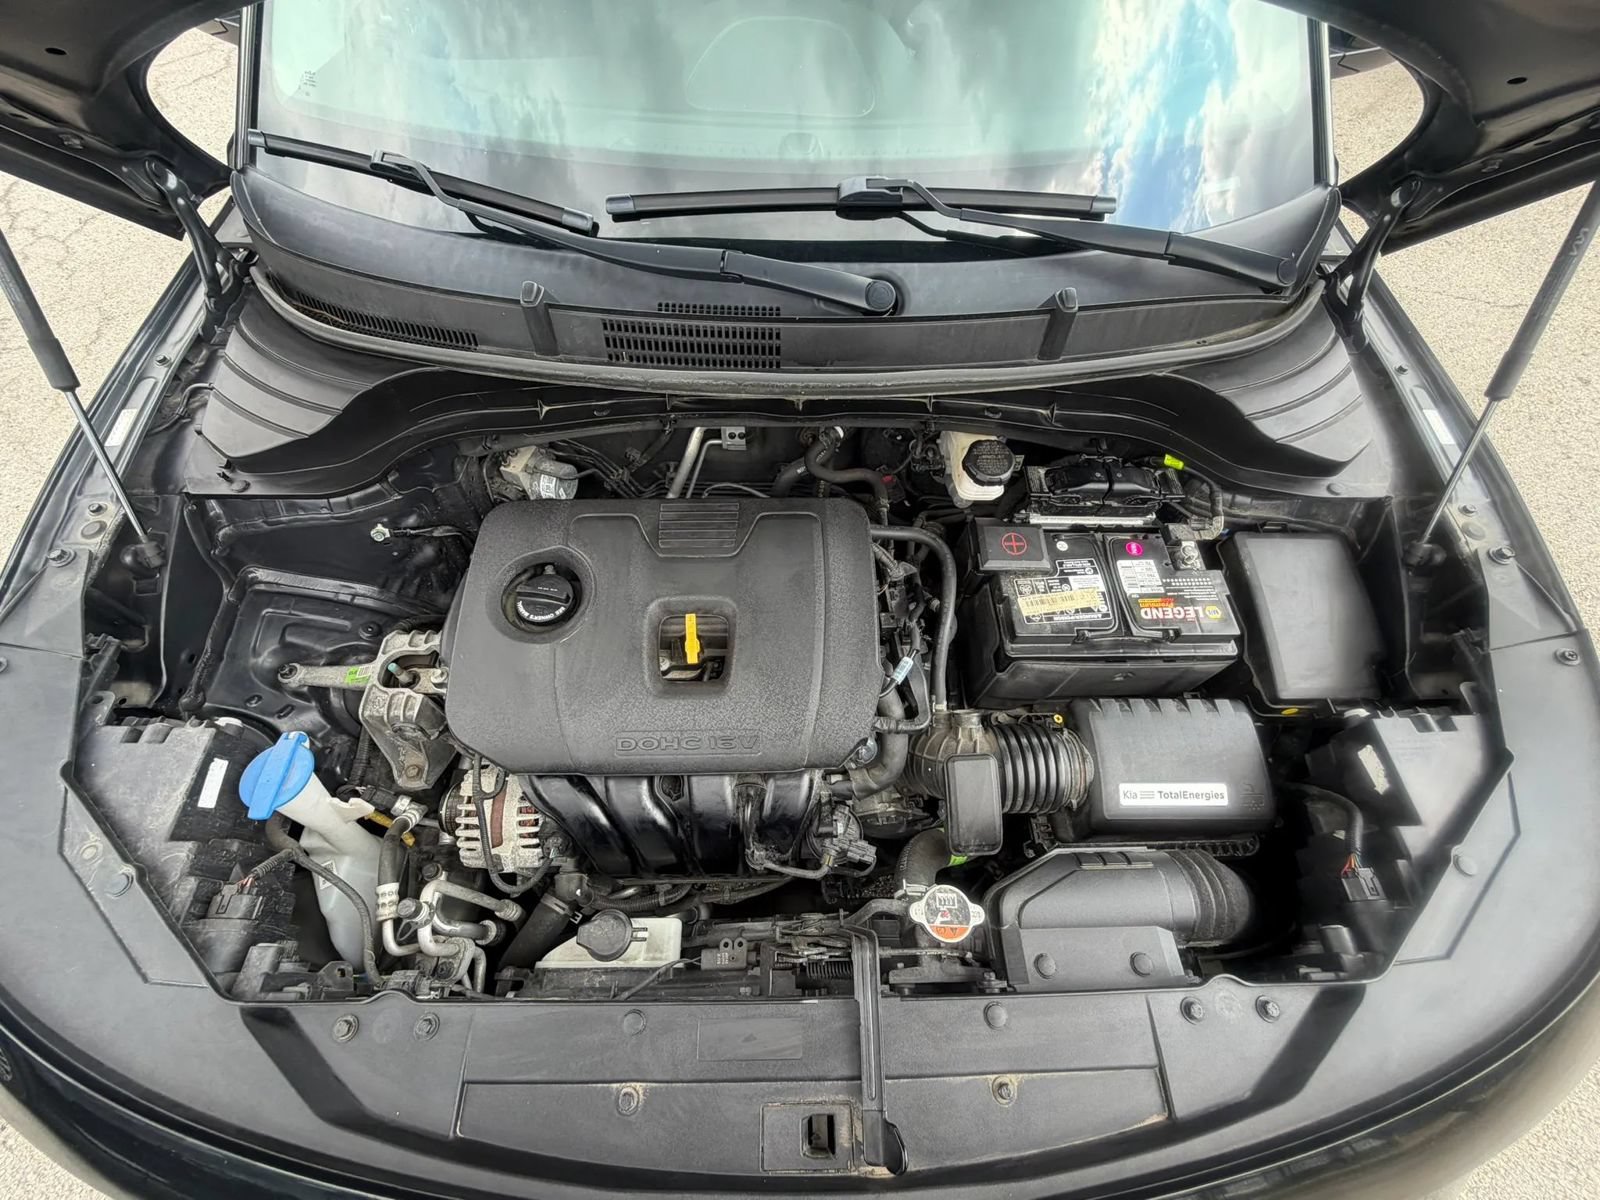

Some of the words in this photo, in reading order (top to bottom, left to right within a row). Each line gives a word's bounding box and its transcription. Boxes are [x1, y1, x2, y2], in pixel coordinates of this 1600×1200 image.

[1140, 606, 1205, 619] LEGEND
[616, 736, 701, 751] DOHC
[708, 735, 759, 750] 16V
[1122, 790, 1138, 800] Kia
[1157, 790, 1225, 801] TotalEnergies
